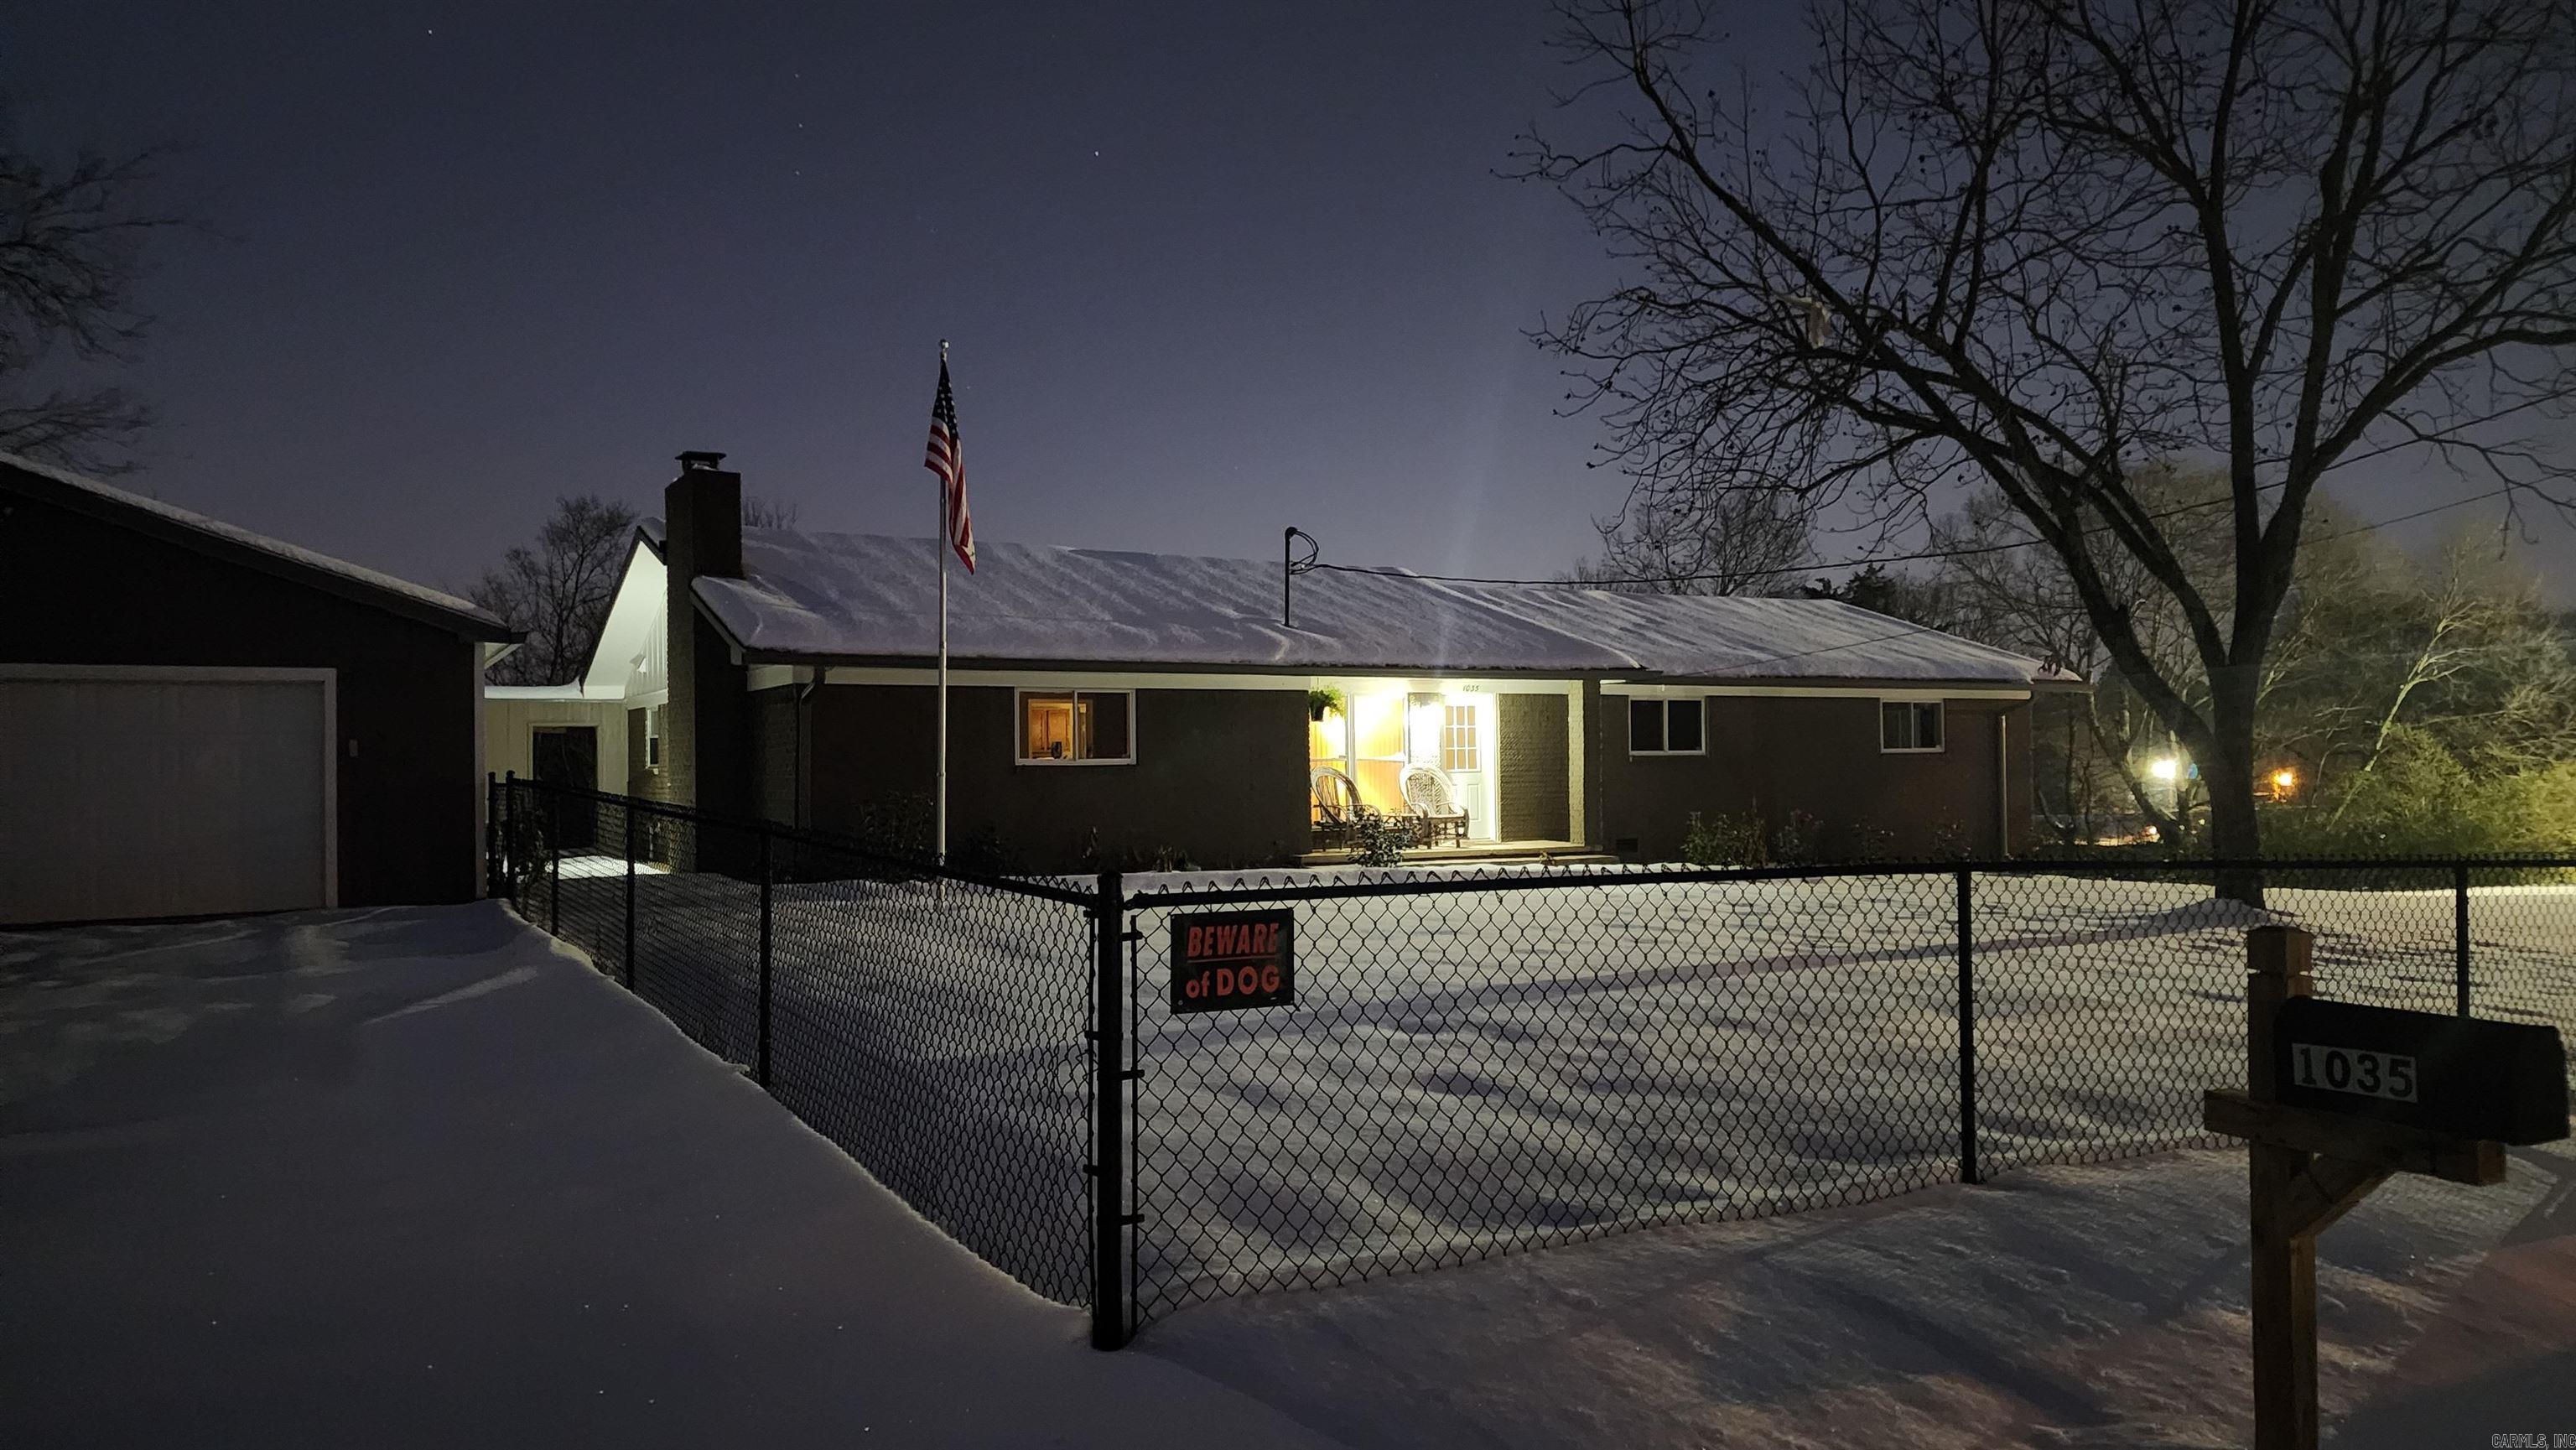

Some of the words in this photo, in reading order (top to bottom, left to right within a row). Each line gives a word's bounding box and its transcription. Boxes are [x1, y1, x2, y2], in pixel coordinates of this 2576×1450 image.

[1462, 683, 1479, 692] 1035
[1187, 922, 1280, 957] BEWARE
[1186, 970, 1210, 998] of
[1217, 964, 1280, 996] DOG
[2299, 1047, 2413, 1099] 1035
